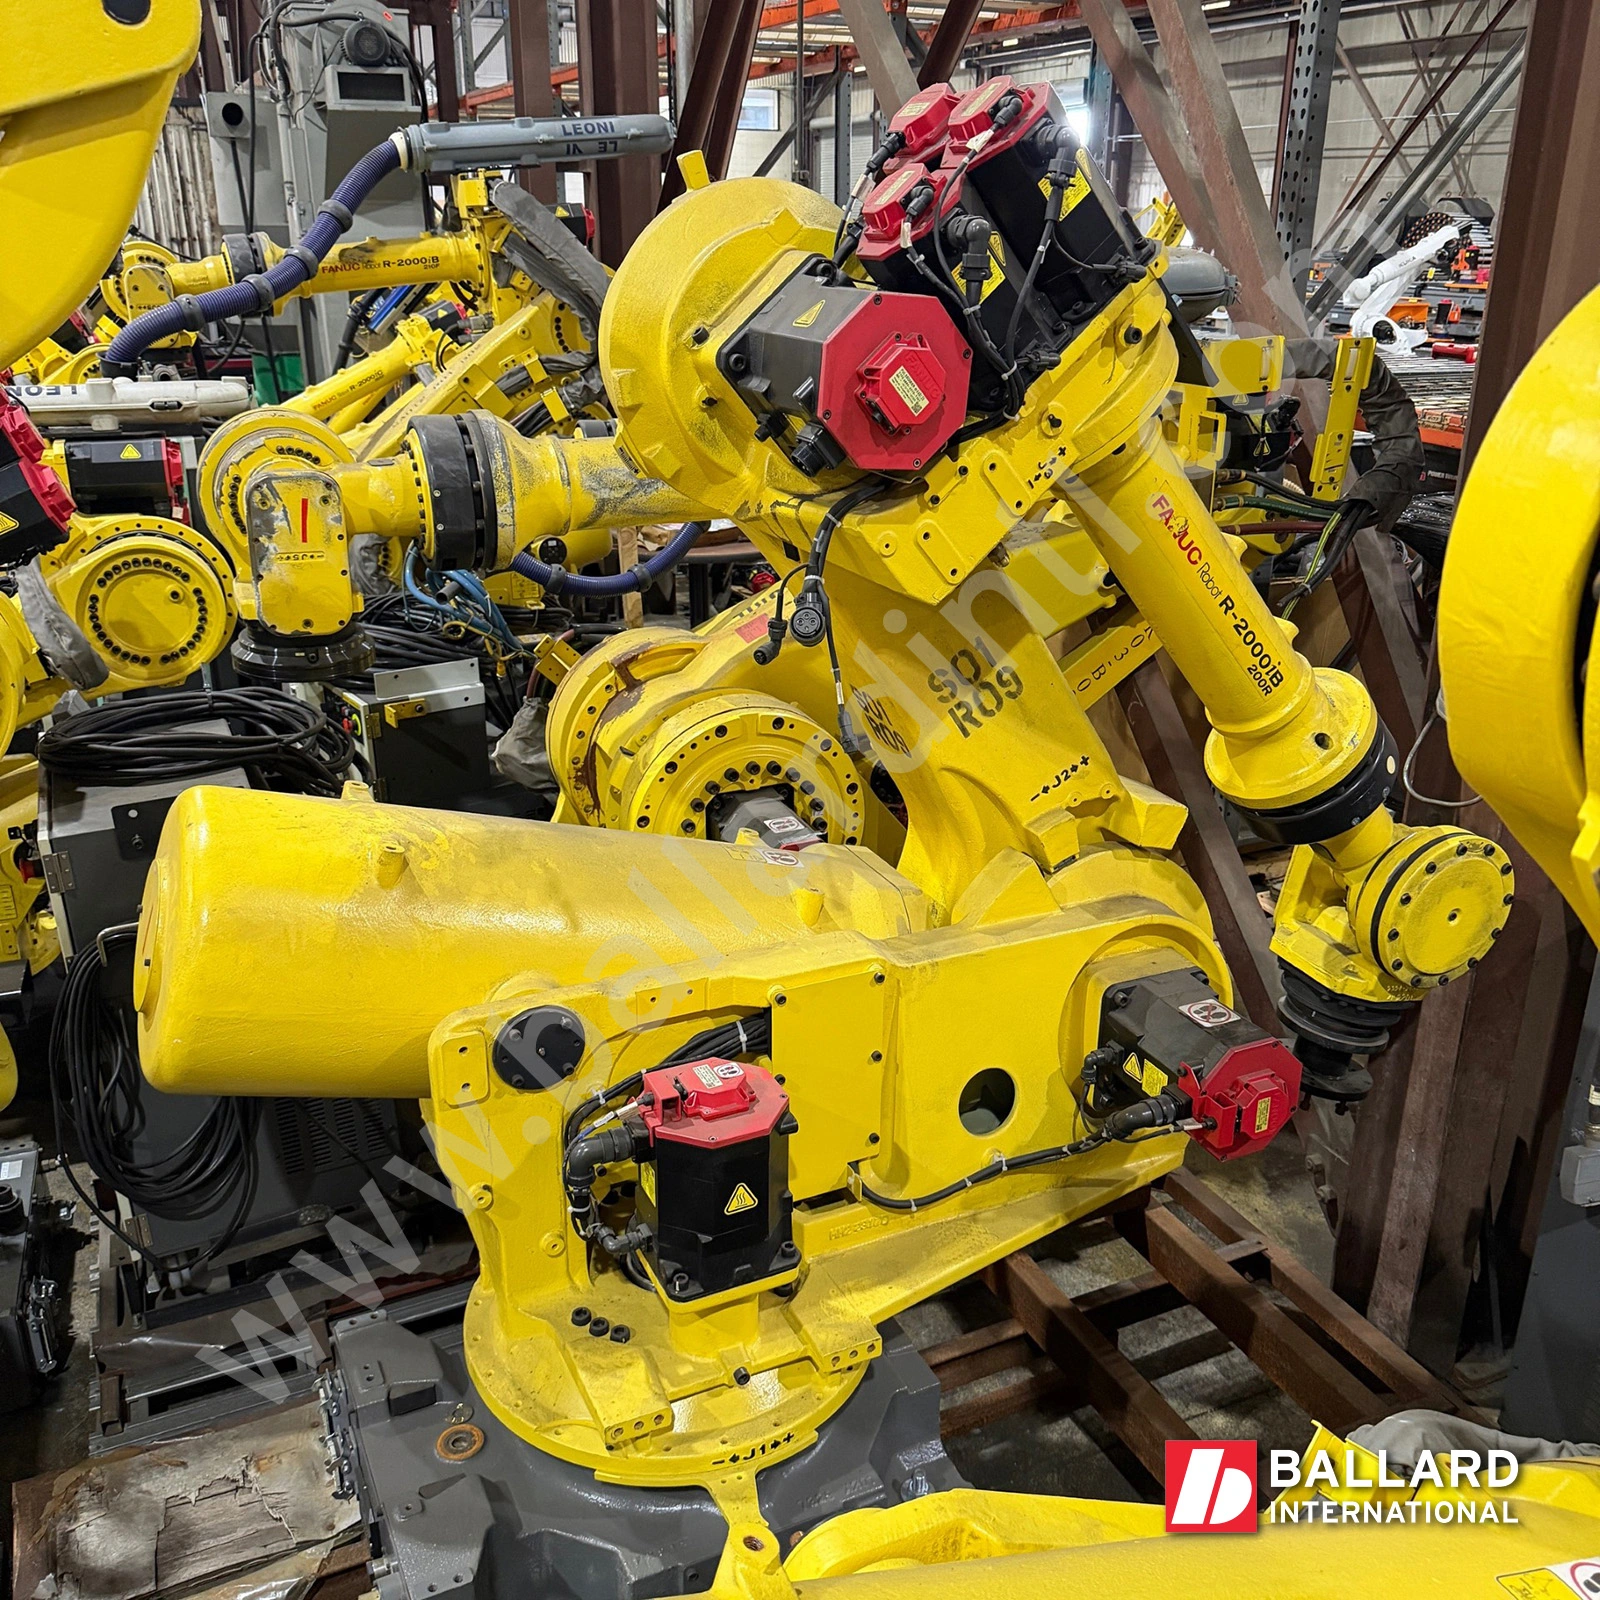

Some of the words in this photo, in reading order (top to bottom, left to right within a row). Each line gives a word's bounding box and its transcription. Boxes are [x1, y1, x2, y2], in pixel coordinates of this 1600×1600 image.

[561, 121, 615, 136] LEONI
[321, 263, 360, 274] FANUC
[383, 256, 440, 268] R-2000iB
[904, 350, 940, 400] FANUC
[1196, 562, 1224, 599] Robot
[1218, 595, 1284, 688] R-2000iB
[1247, 664, 1273, 697] 200R
